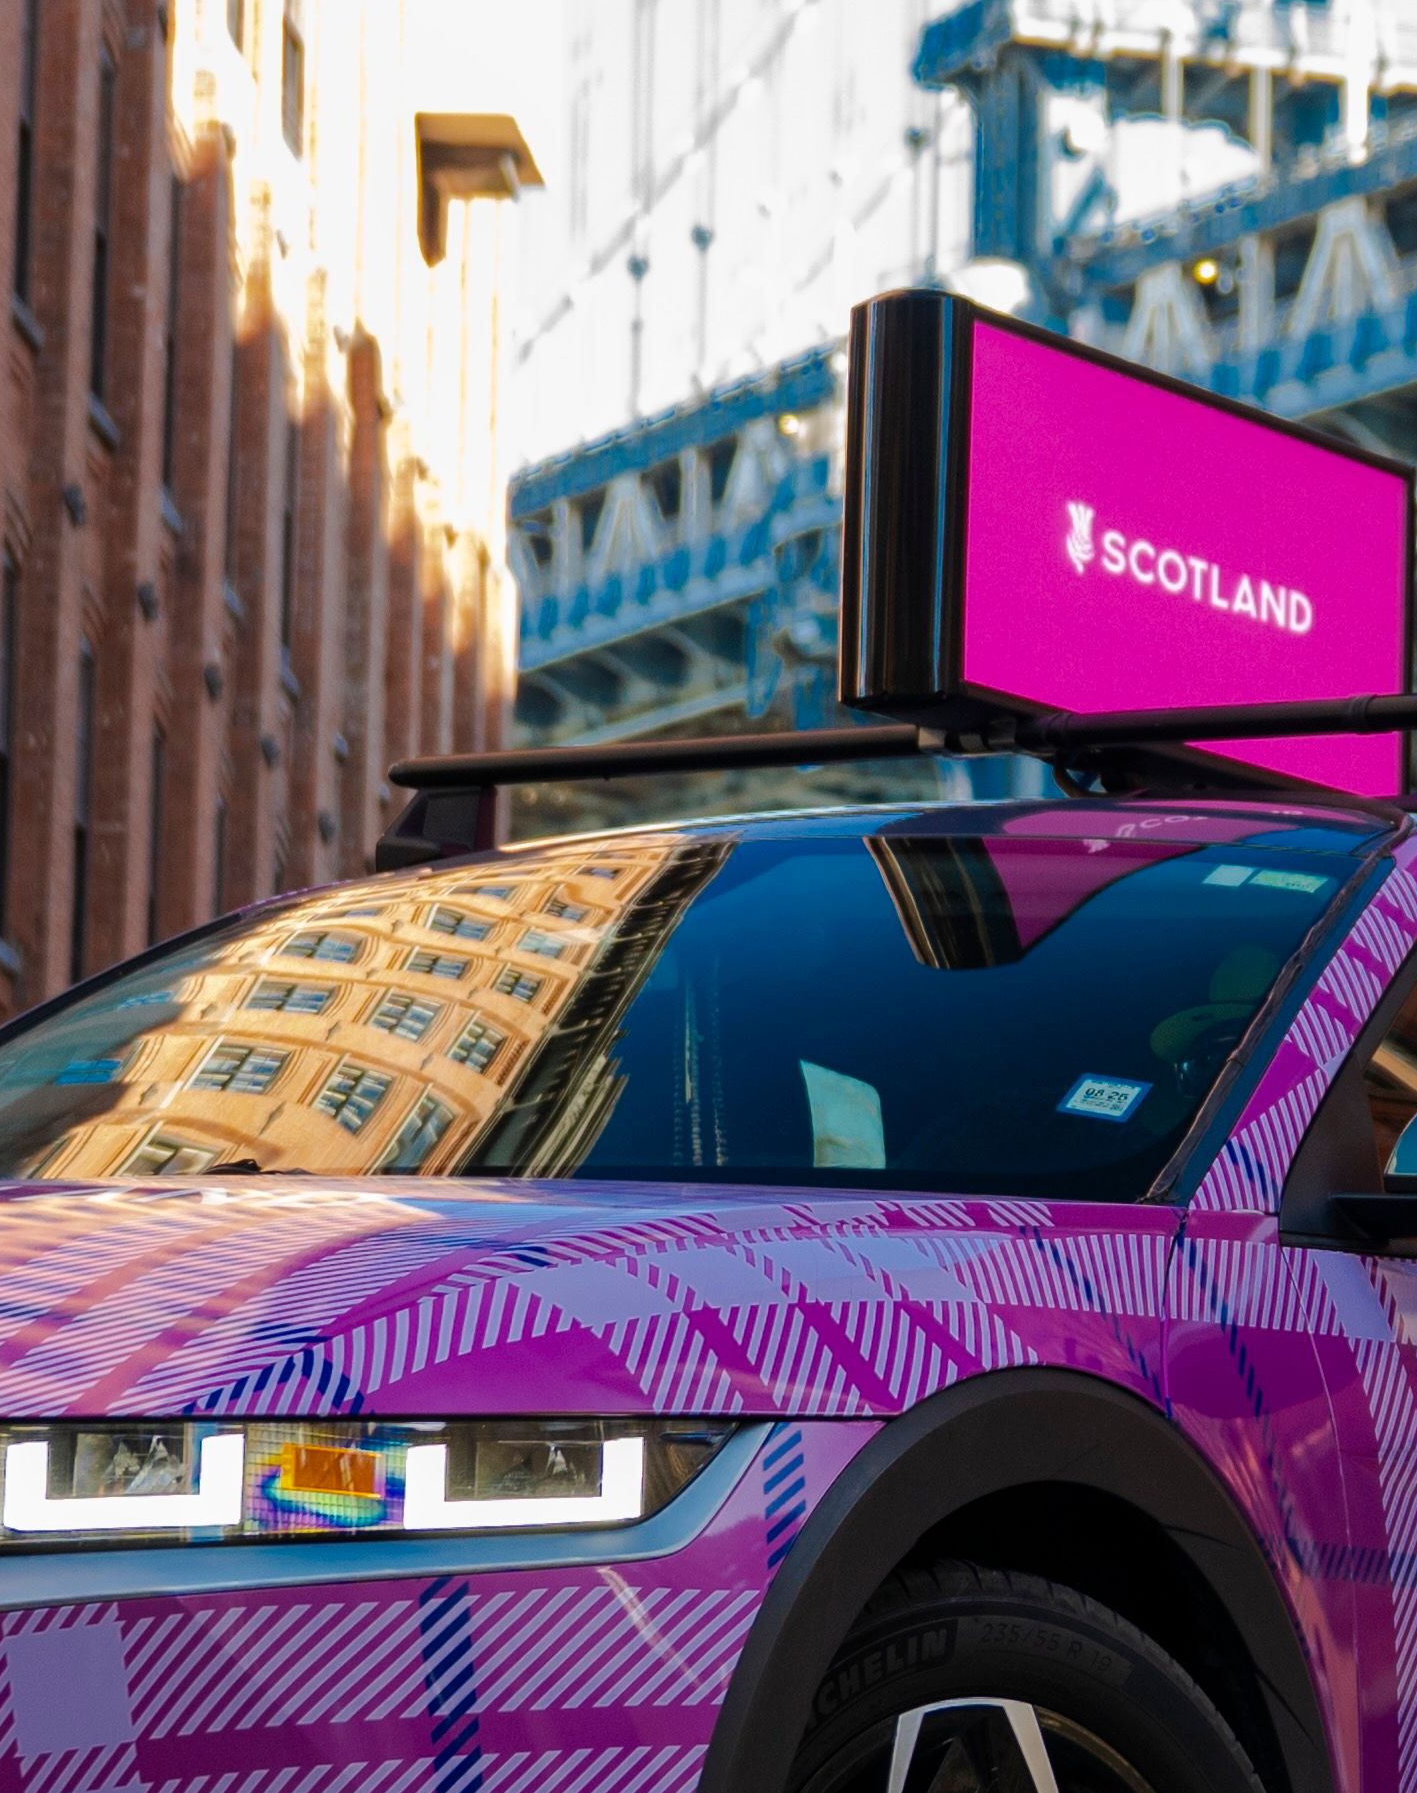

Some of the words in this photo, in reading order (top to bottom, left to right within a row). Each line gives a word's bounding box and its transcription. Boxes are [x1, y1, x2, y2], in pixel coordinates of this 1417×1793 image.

[1100, 529, 1314, 635] SCOTLAND
[818, 1629, 947, 1714] CHELIN
[980, 1622, 1060, 1653] 235/55
[1066, 1640, 1082, 1657] R
[1091, 1650, 1113, 1673] 19
